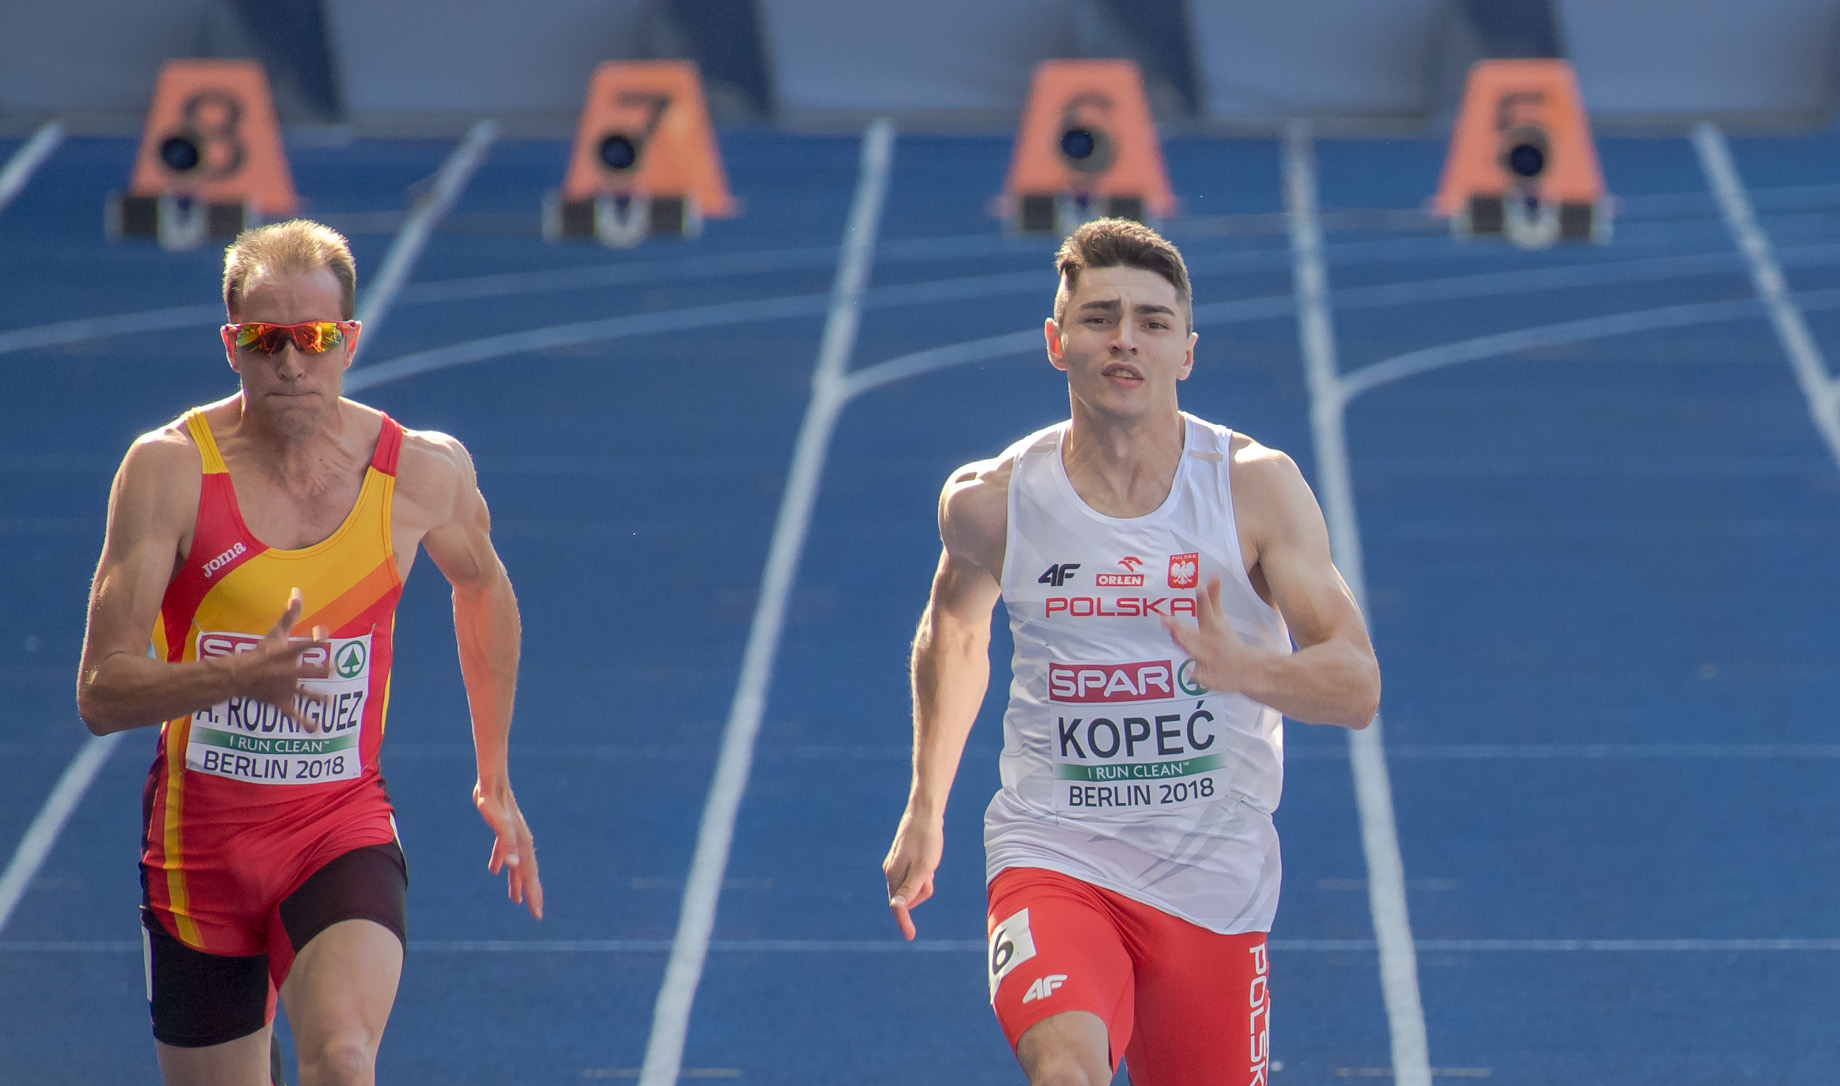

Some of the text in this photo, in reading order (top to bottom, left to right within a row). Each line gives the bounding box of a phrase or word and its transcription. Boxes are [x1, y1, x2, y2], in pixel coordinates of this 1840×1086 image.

[181, 88, 246, 180] 8
[612, 91, 671, 172] 7
[1059, 92, 1117, 173] 6
[1497, 91, 1550, 174] 5
[1037, 563, 1081, 587] 4F
[1098, 575, 1142, 586] ORLEN
[1045, 596, 1197, 618] POLSKA
[203, 638, 328, 670] SR
[1050, 665, 1171, 698] SPAR
[229, 735, 234, 747] I
[237, 737, 271, 752] RUN
[1058, 700, 1216, 759] KOPEĆ
[203, 750, 345, 779] BERLIN 2018
[1087, 767, 1091, 780] I
[1096, 766, 1130, 780] RUN
[1069, 777, 1215, 807] BERLIN 2018
[992, 928, 1014, 974] 6
[1022, 973, 1068, 1004] 4F
